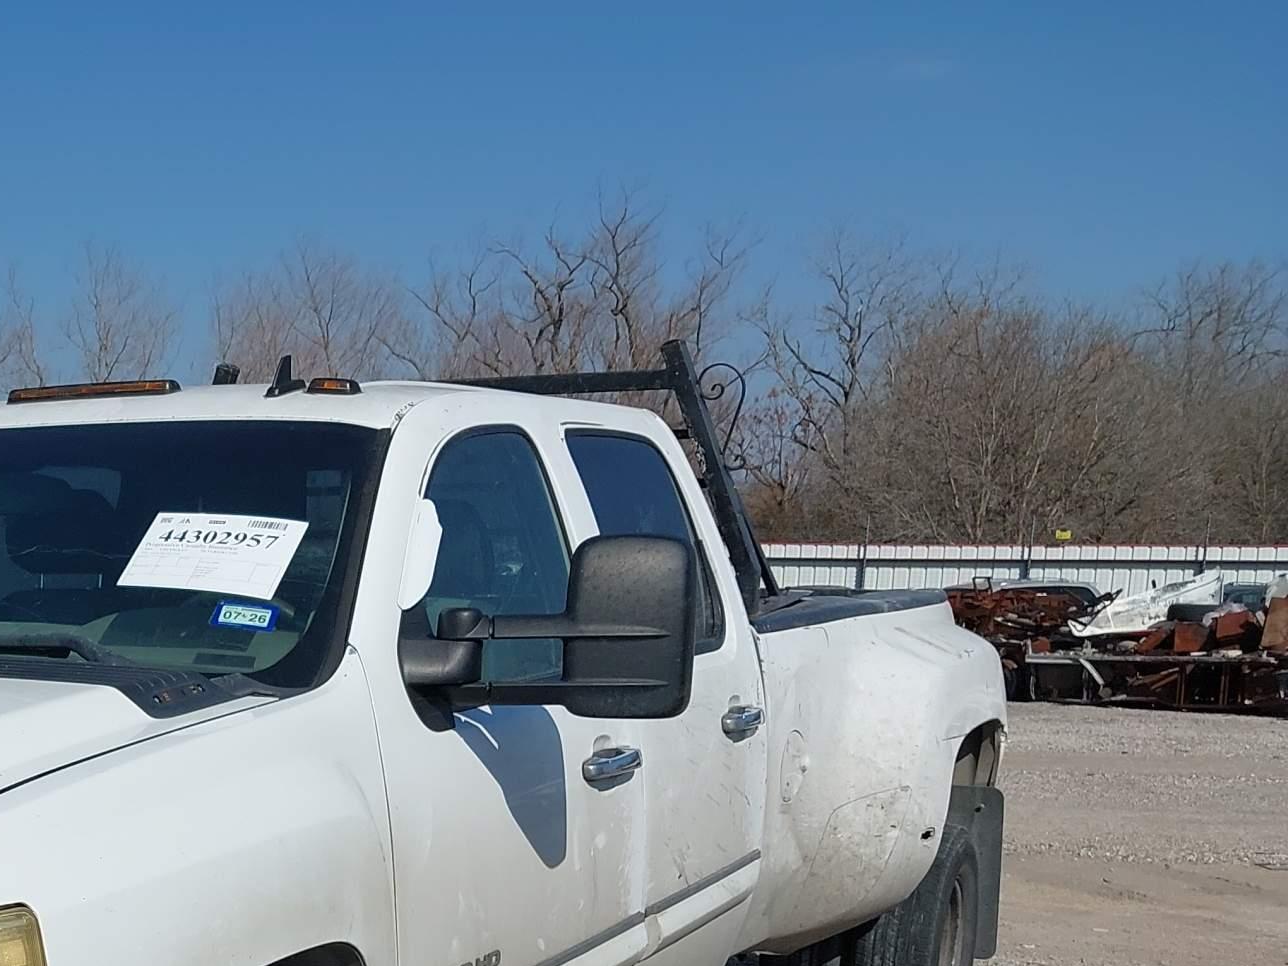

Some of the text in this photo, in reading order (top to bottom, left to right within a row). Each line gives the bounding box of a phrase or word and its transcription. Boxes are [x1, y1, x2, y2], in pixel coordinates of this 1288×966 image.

[158, 529, 279, 549] 44302957
[223, 610, 242, 621] 07
[248, 613, 268, 624] 26
